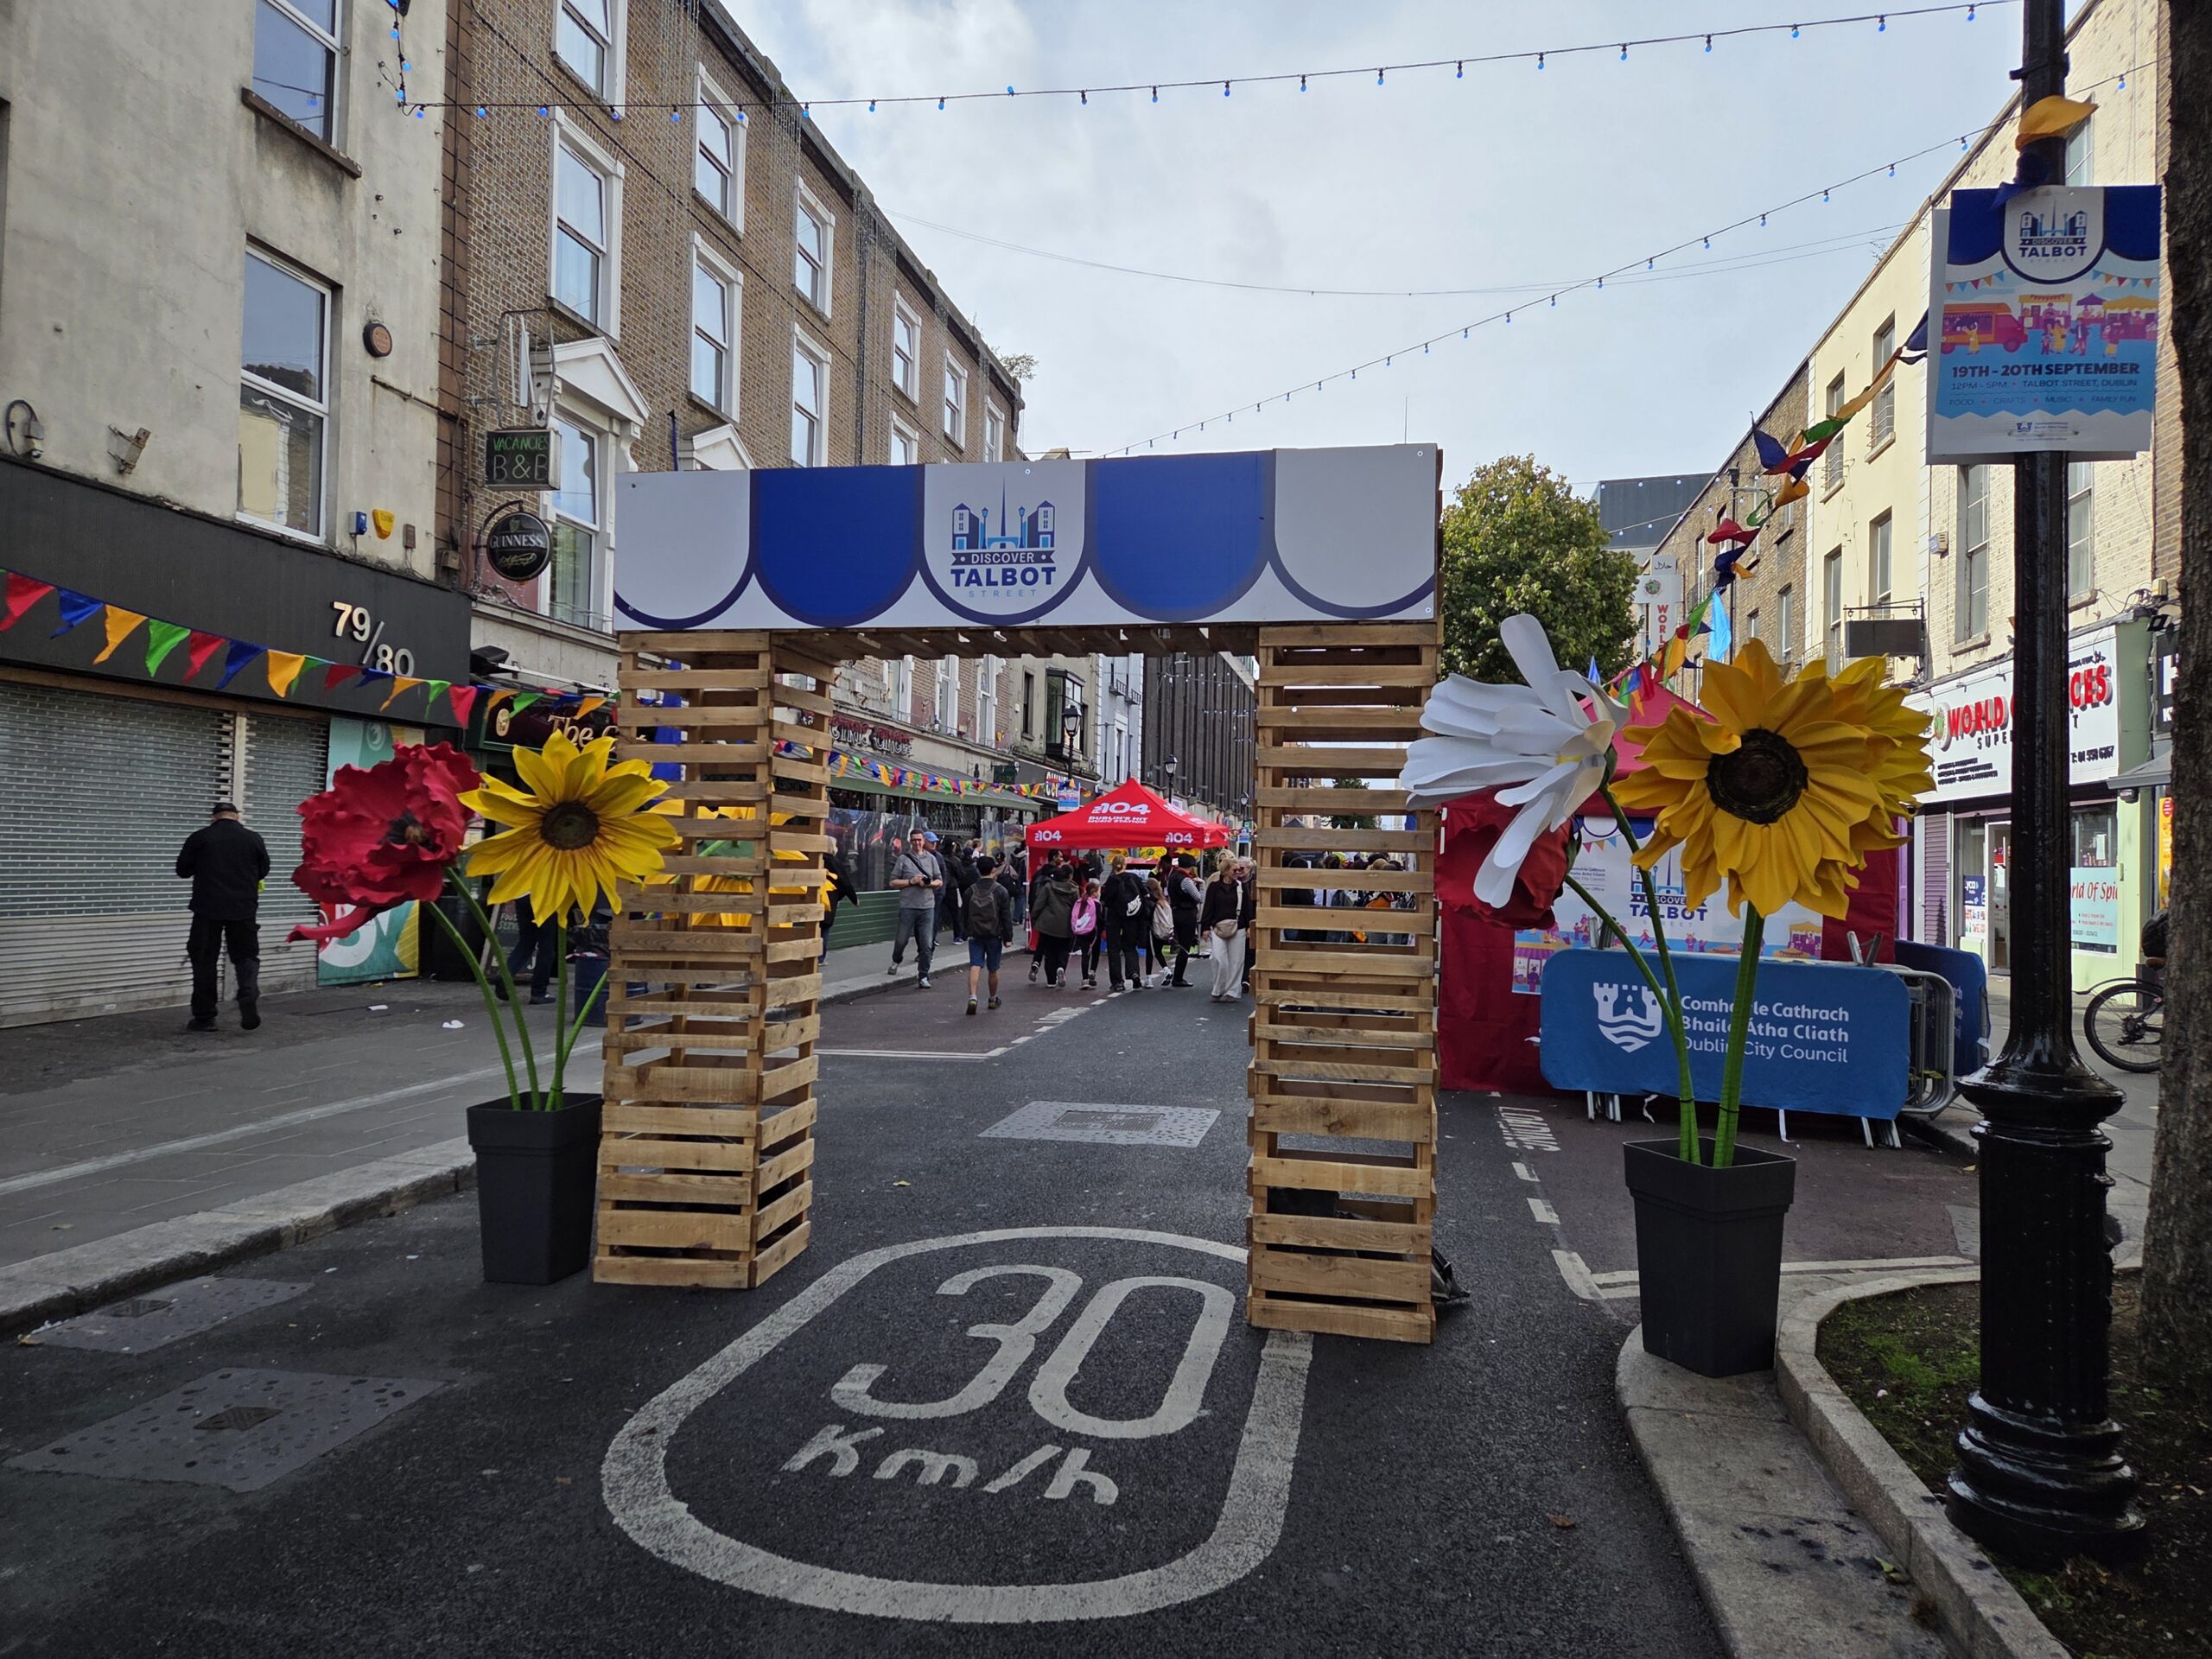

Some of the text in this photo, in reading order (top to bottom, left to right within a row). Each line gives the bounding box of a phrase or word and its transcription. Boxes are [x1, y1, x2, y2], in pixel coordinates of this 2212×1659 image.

[2018, 245, 2088, 257] TALBOT
[1952, 365, 1990, 378] 19TH
[2000, 364, 2043, 376] 20TH
[2044, 363, 2140, 375] SEPTEMBER
[493, 454, 508, 481] B
[512, 454, 531, 479] &
[490, 533, 546, 549] GUINNESS
[971, 552, 1035, 564] DISCOVER
[1654, 562, 1672, 570] حلال
[950, 567, 1056, 587] TALBOT
[969, 589, 1037, 598] STREET
[1657, 605, 1669, 647] WORL
[1948, 696, 2007, 738] WORLD
[1630, 904, 1708, 921] TALBOT
[1681, 995, 1849, 1021] Comhle Cathrach
[1746, 1017, 1788, 1038] Átha
[1793, 1024, 1849, 1042] Cliath
[1743, 1040, 1775, 1059] City
[1780, 1044, 1848, 1063] Council
[830, 1264, 1236, 1440] 30
